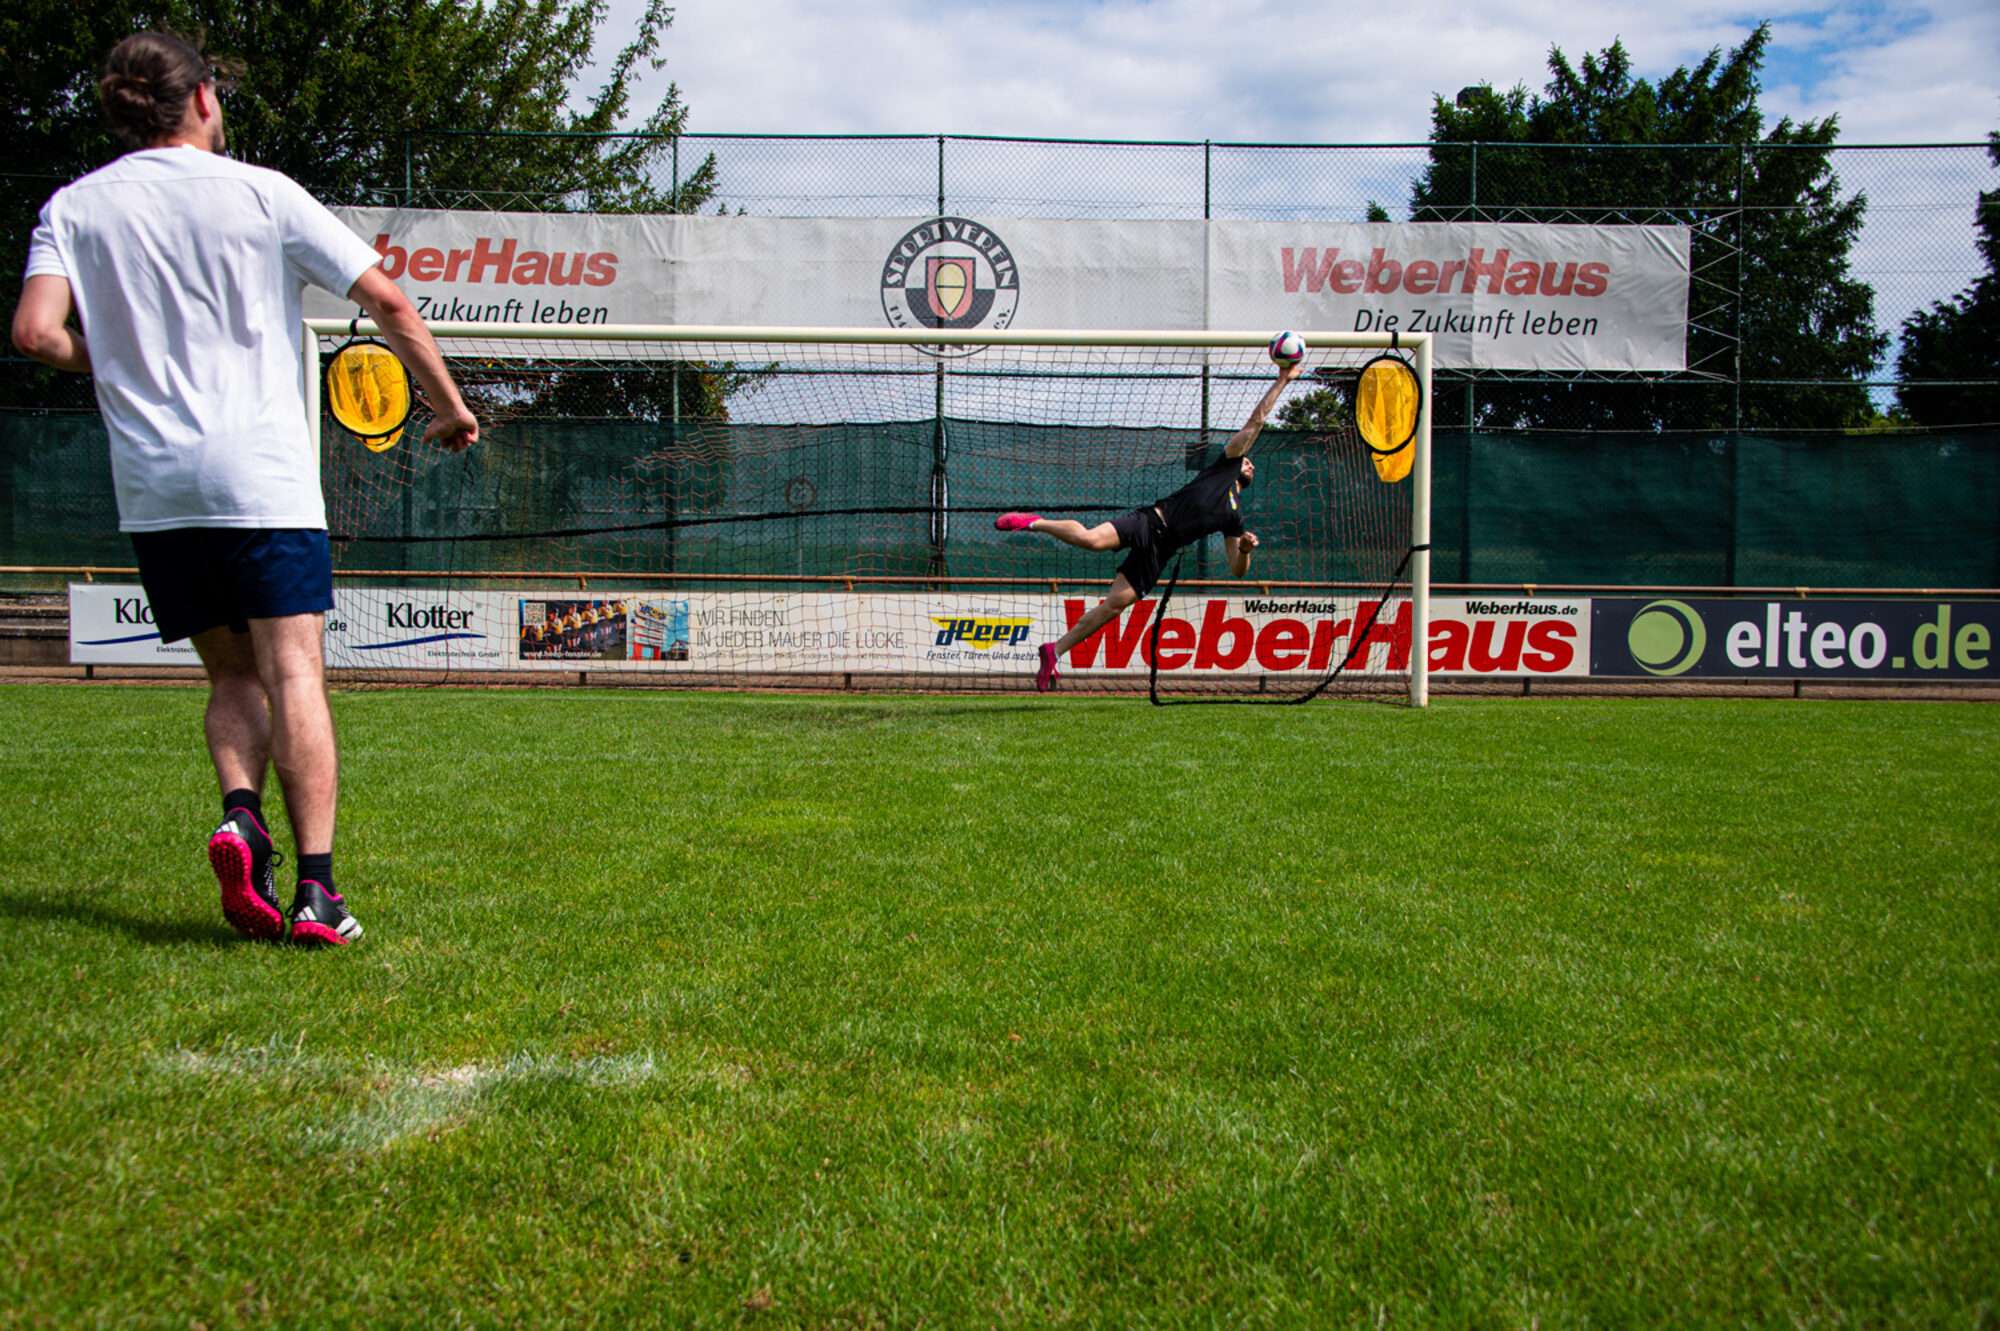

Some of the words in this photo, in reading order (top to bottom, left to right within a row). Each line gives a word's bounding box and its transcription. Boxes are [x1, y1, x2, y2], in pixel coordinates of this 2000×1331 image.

[373, 234, 619, 287] berHaus
[886, 221, 1017, 288] SPORTVEREIN
[1280, 246, 1611, 298] WeberHaus
[416, 296, 524, 324] Zukunft
[531, 299, 608, 325] leben
[1353, 308, 1398, 334] Die
[1407, 309, 1515, 340] Zukunft
[1522, 310, 1598, 336] leben
[385, 602, 474, 629] Klotter
[696, 609, 725, 627] WIR
[730, 609, 784, 627] FINDEN
[1244, 599, 1337, 614] WeberHaus
[1465, 600, 1579, 616] WeberHaus.de
[325, 619, 348, 632] .de
[696, 631, 712, 648] IN
[716, 631, 764, 648] JEDER
[768, 631, 822, 648] MAUER
[827, 631, 851, 649] DIE
[855, 628, 909, 649] LÜCKE.
[1064, 599, 1578, 673] WeberHaus
[1725, 602, 1992, 671] elteo.de
